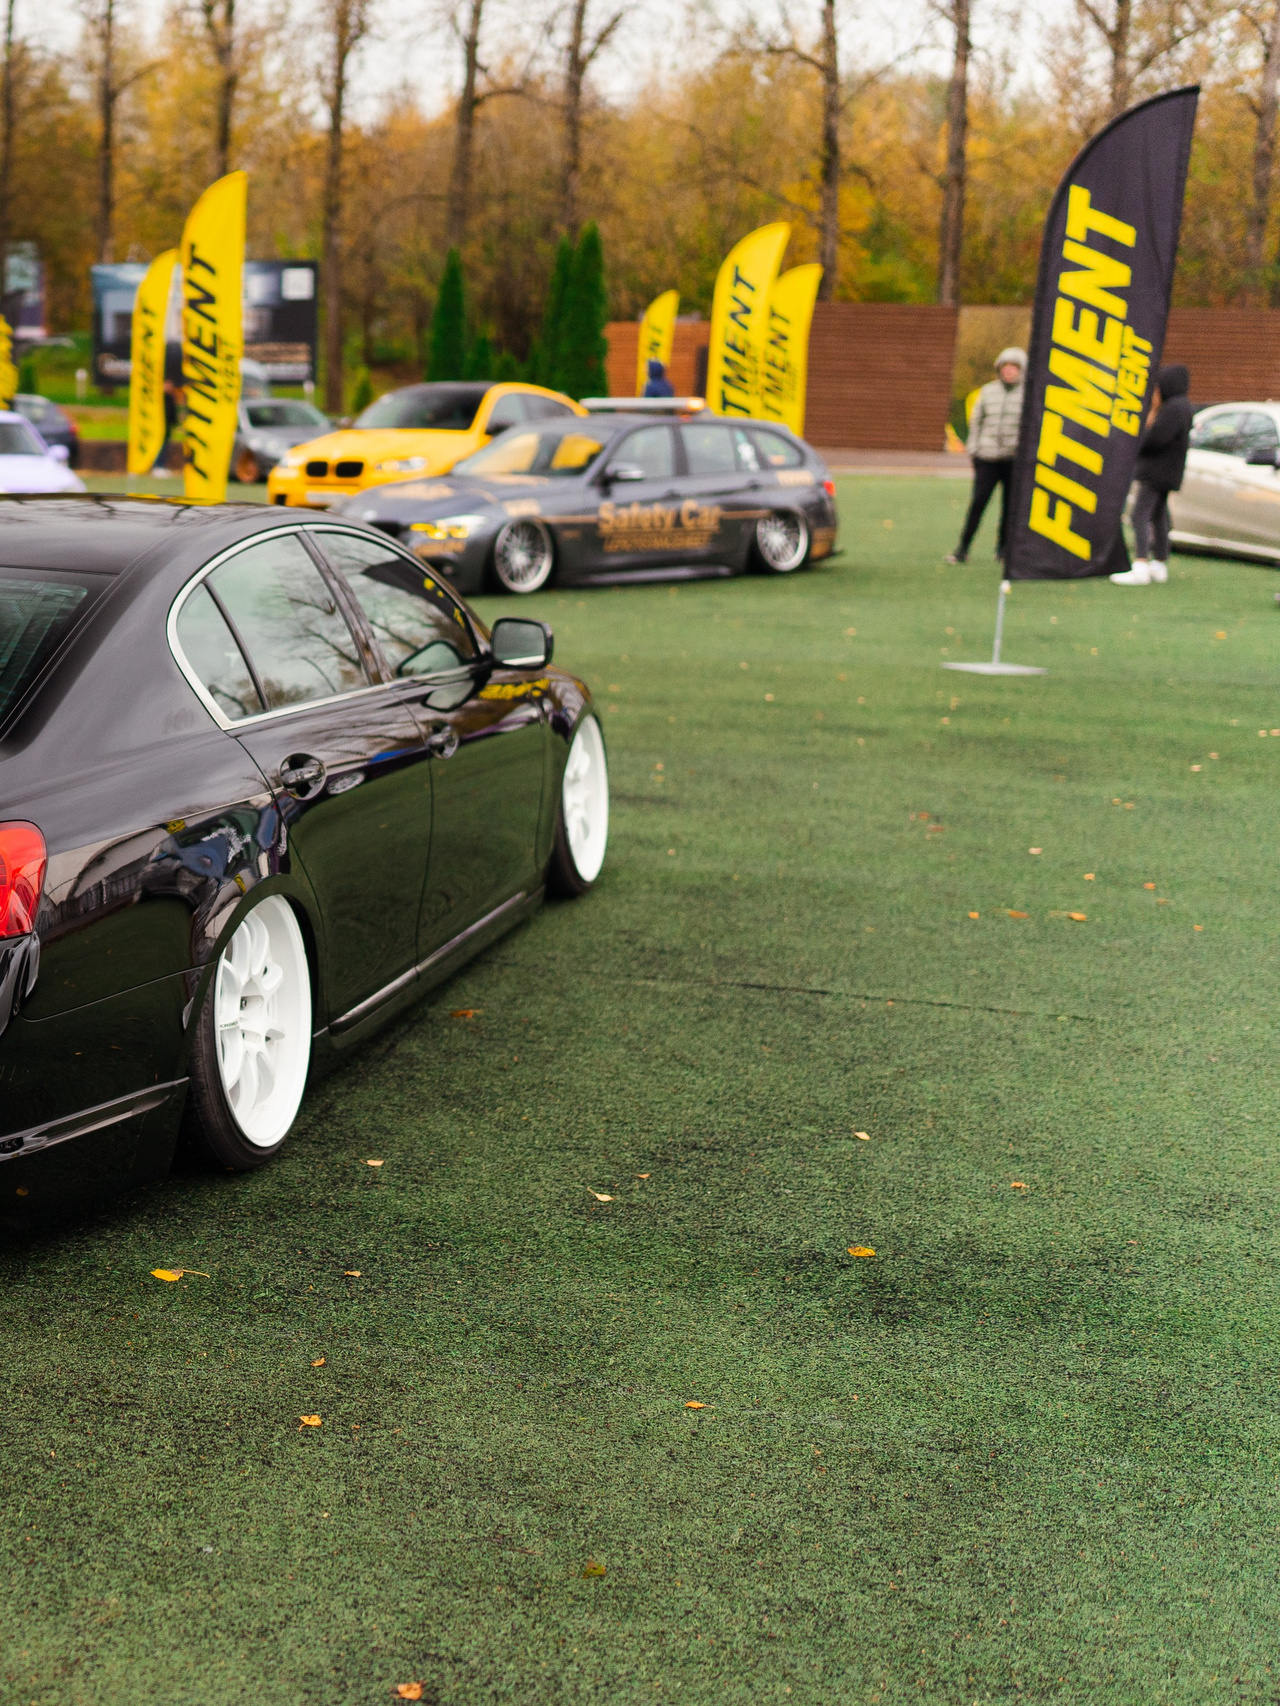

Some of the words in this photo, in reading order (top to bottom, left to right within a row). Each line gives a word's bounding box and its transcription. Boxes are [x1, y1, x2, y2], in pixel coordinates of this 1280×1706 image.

[720, 264, 756, 415] TMENT
[1028, 184, 1137, 561] FITMENT
[1111, 325, 1154, 437] EVENT
[599, 501, 676, 534] Safety
[681, 499, 720, 532] Car
